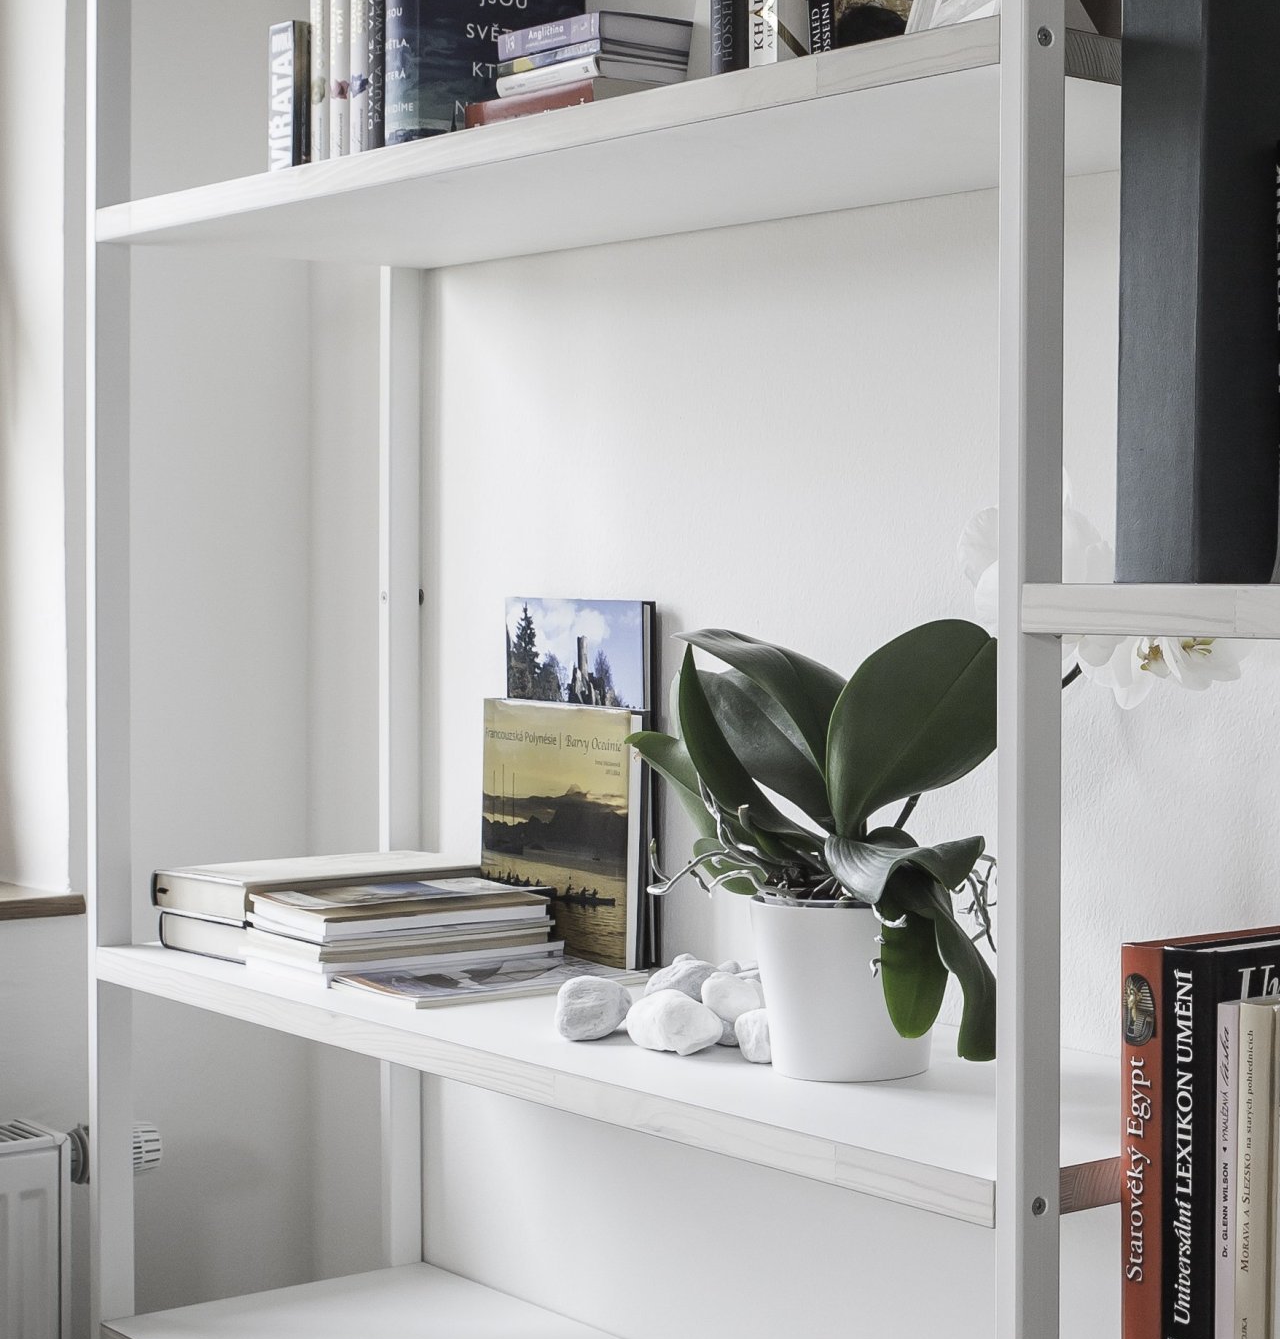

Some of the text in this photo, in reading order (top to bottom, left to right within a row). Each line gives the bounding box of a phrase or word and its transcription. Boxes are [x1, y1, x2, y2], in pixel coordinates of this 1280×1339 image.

[368, 39, 374, 63] VE
[528, 24, 564, 40] Angličtina
[811, 7, 821, 55] HALED
[374, 64, 383, 122] PAULA
[485, 727, 523, 742] Francouzská
[524, 731, 557, 747] Polynésie
[566, 734, 589, 756] Barvy
[1220, 1090, 1229, 1142] VYNALÉZAVÁ
[1125, 1055, 1151, 1282] Starověký Egypt
[1172, 968, 1194, 1325] Universální LEXIKON UMĚNÍ
[1240, 1029, 1255, 1272] MORAVA A SLEZSKO na starých pohlednicích
[1221, 1162, 1229, 1203] WILSON
[1221, 1205, 1229, 1242] GLENN
[1221, 1244, 1229, 1258] Dr.
